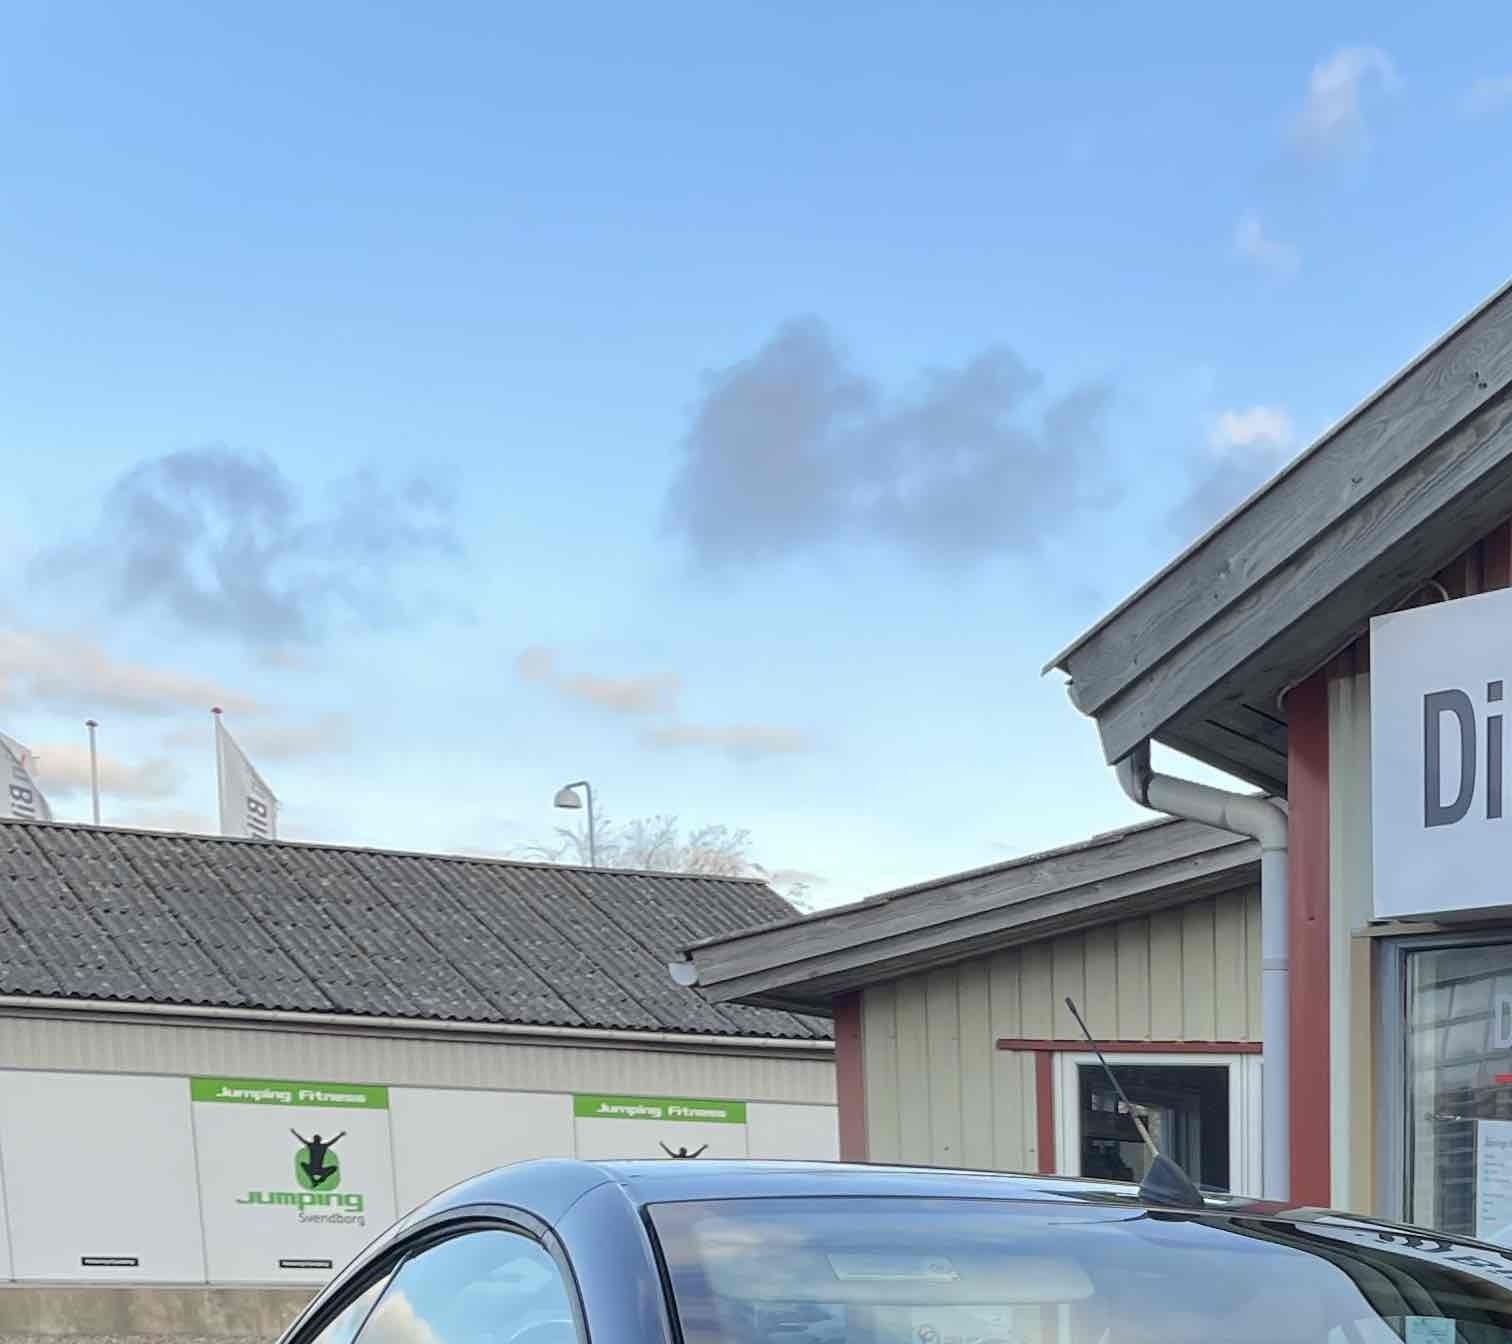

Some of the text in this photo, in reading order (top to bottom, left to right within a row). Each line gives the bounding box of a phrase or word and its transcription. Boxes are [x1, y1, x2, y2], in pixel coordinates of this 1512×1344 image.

[216, 1086, 366, 1103] Jumping Fitness
[596, 1103, 727, 1118] Jumping Fitness
[299, 1213, 365, 1226] Svendborg
